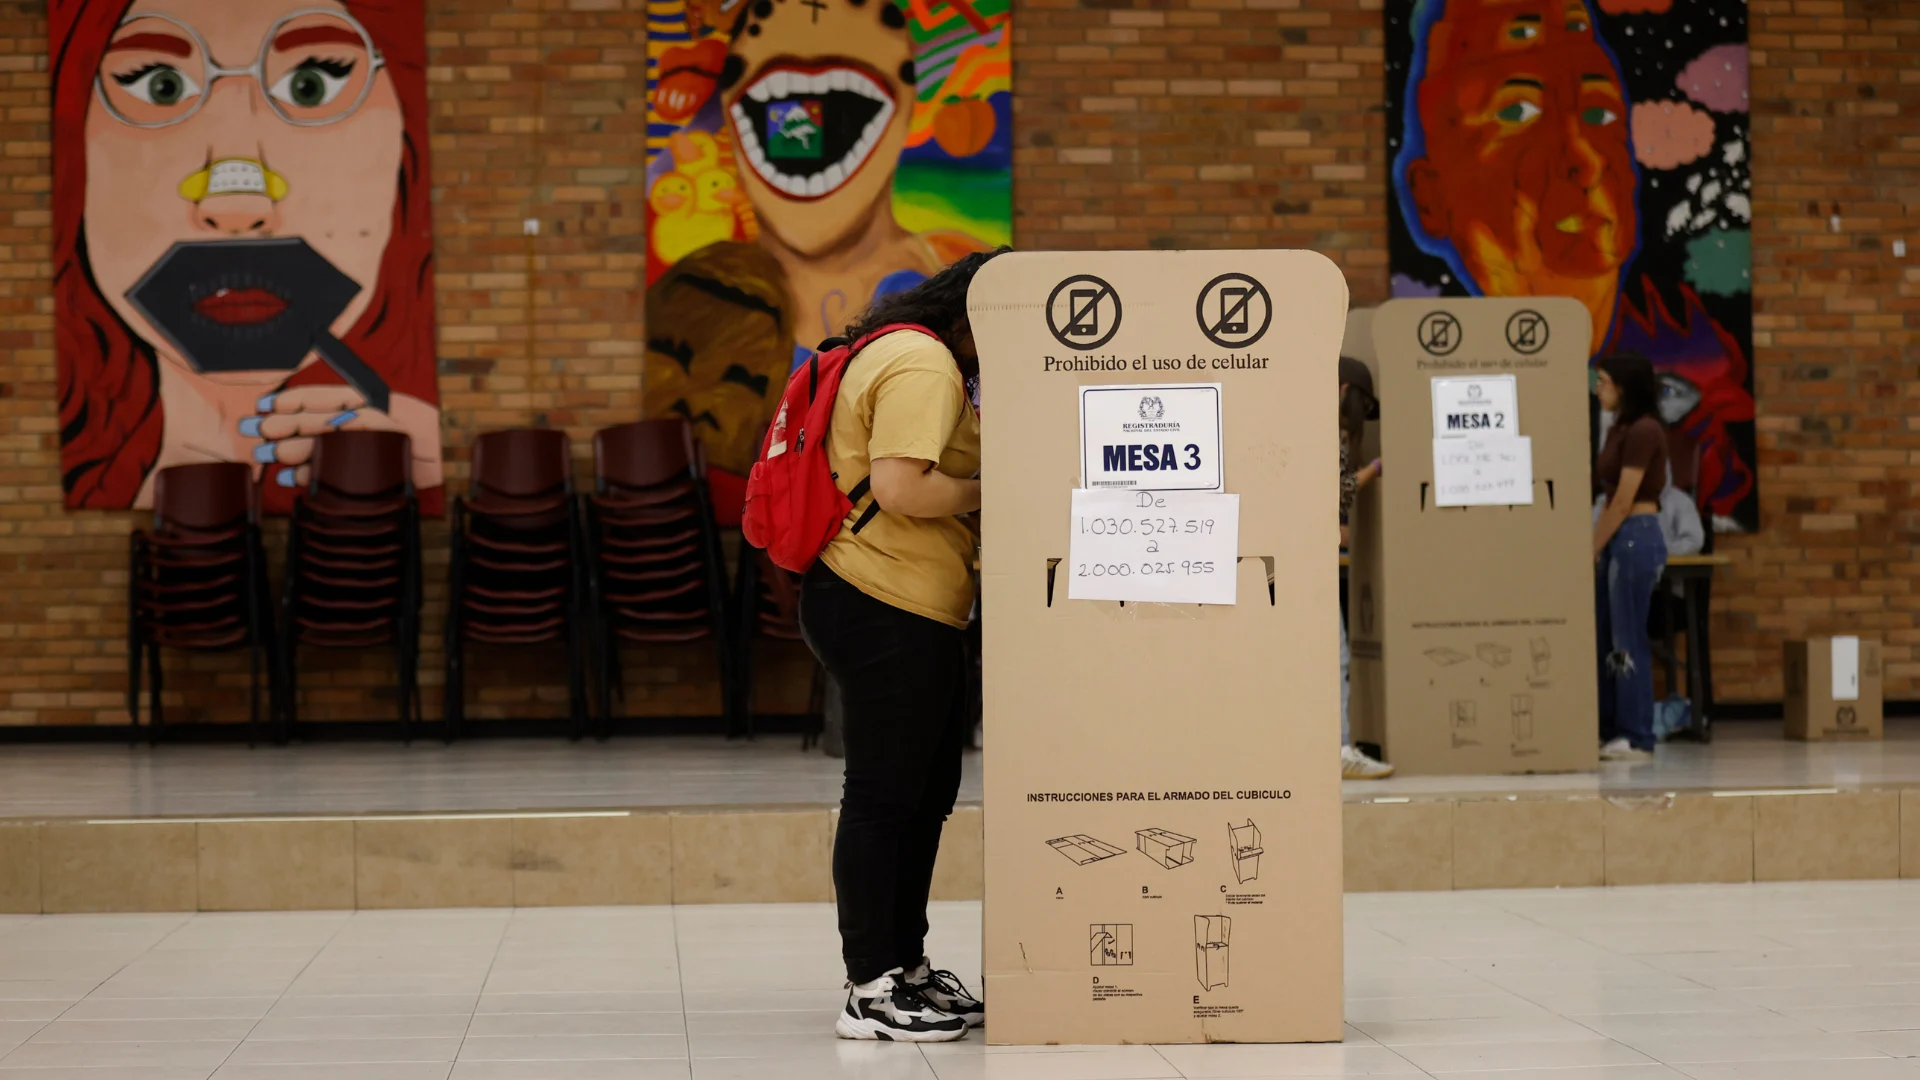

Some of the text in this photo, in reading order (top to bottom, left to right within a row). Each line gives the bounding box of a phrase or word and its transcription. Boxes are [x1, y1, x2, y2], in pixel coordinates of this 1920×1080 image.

[1043, 353, 1269, 371] Prohibido el uso de celular
[1122, 421, 1181, 430] REGISTRADURÍA
[1447, 412, 1505, 431] MESA 2
[1103, 443, 1202, 472] MESA 3
[1136, 492, 1167, 509] De
[1027, 790, 1292, 802] INSTRUCCIONES PARA EL ARMADO DEL CUBICULO
[1056, 887, 1063, 895] A
[1142, 886, 1149, 894] B
[1220, 885, 1227, 893] C
[1092, 976, 1099, 984] D
[1193, 995, 1200, 1004] E
